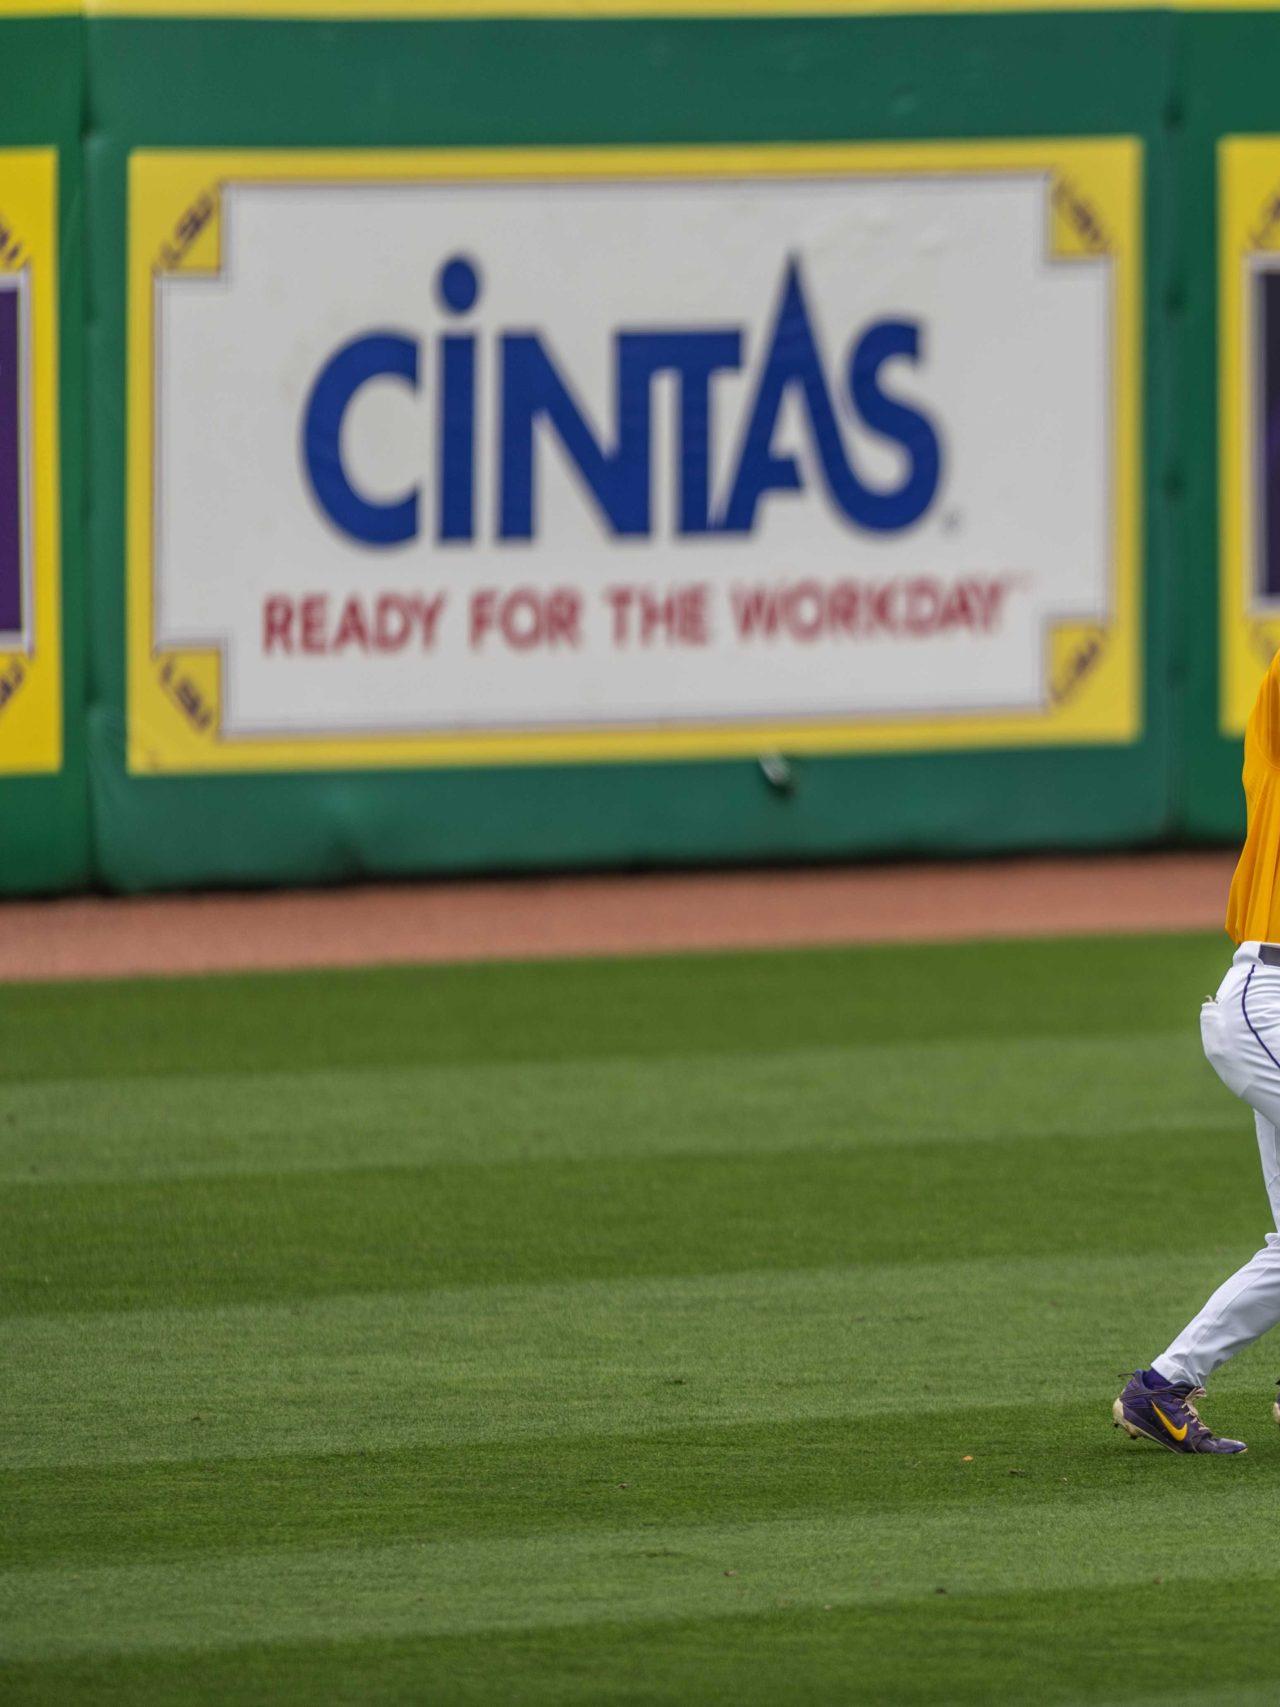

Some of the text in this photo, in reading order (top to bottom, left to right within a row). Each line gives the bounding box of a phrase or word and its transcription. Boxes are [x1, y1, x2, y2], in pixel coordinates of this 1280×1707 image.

[262, 575, 1006, 656] READY FOR THE WORKDAY
